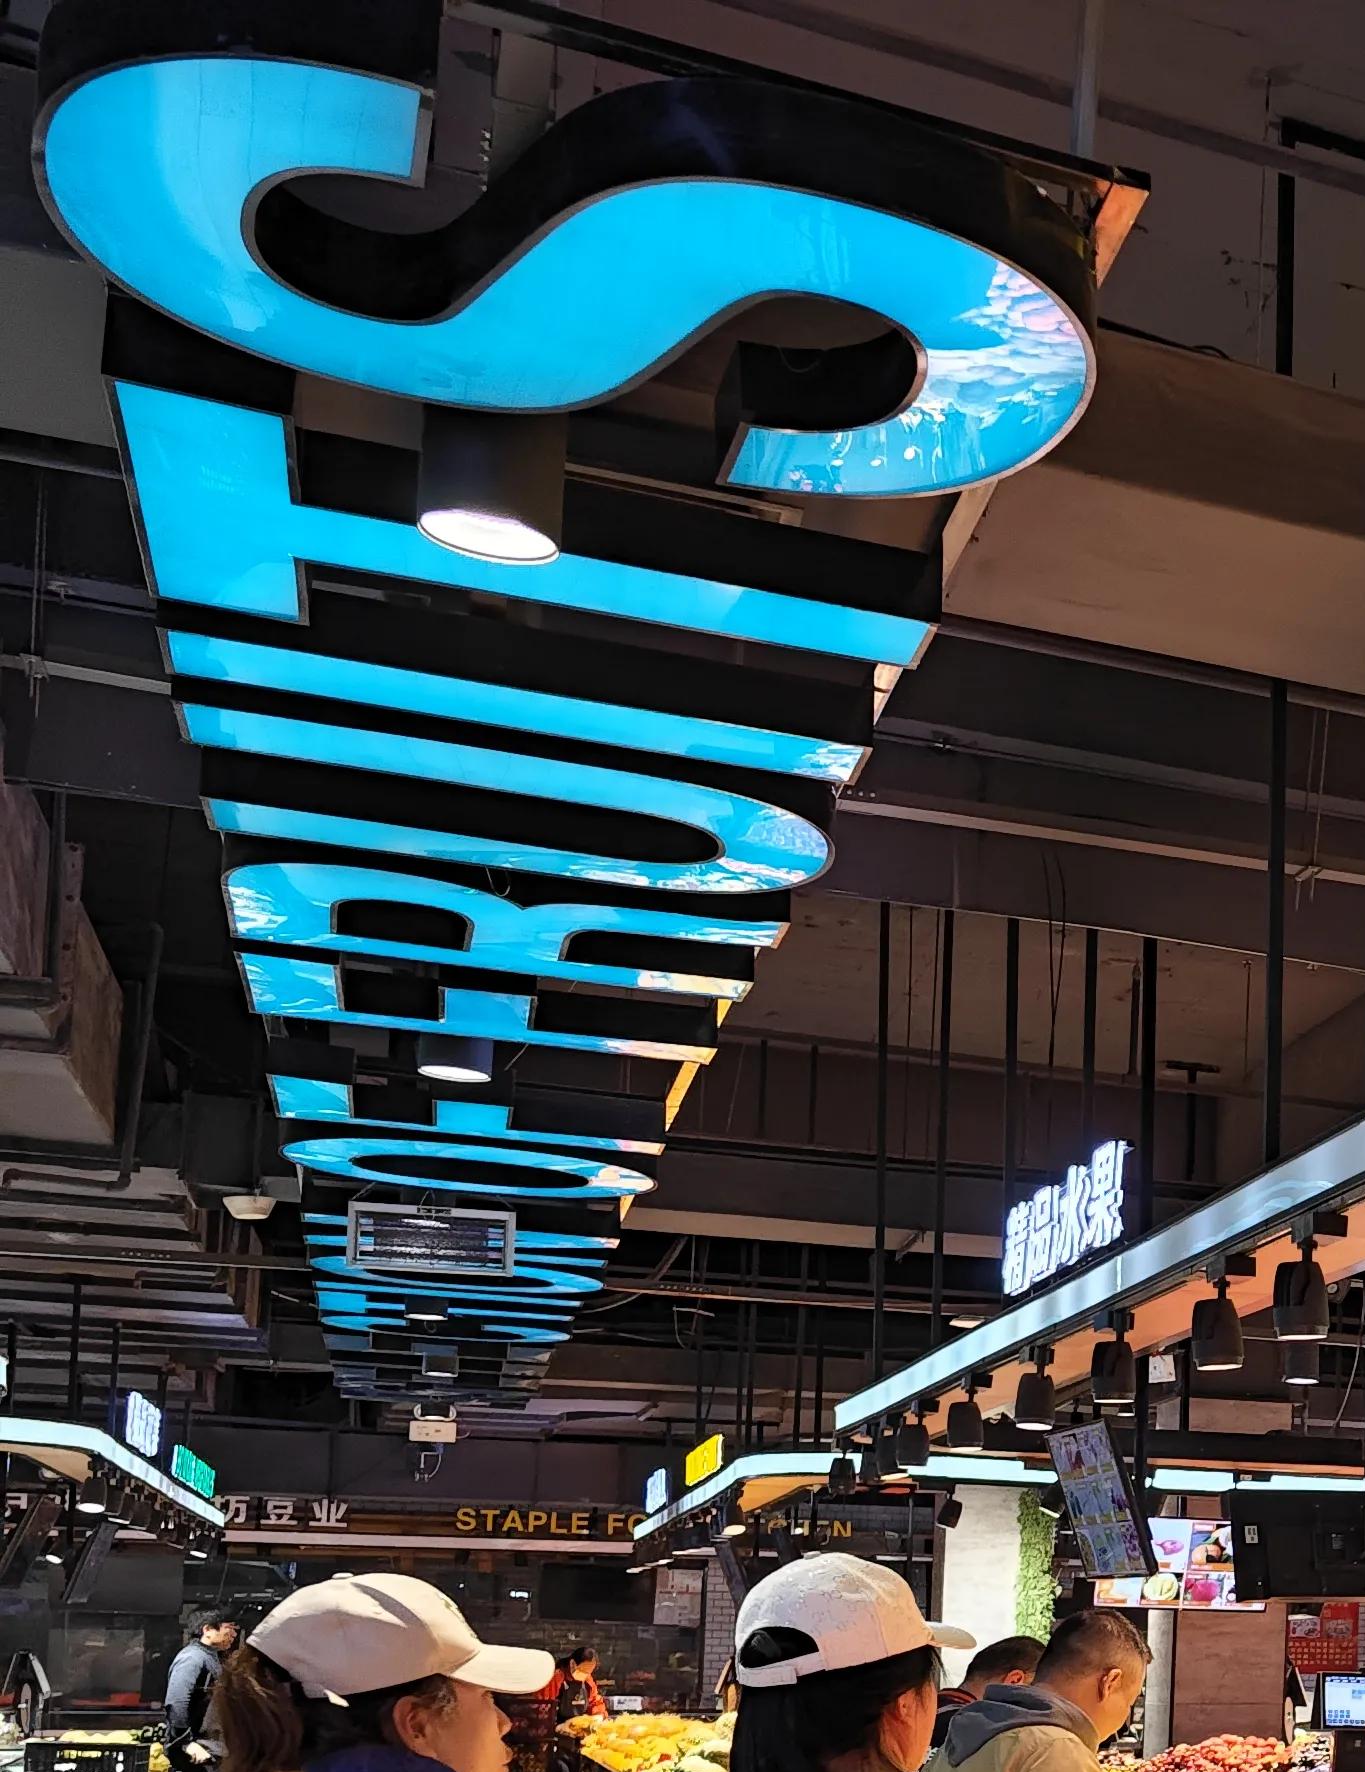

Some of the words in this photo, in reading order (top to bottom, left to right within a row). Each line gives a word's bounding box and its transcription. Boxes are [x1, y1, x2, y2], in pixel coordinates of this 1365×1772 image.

[35, 55, 1098, 1065] FRUITS
[1002, 1139, 1128, 1297] 精品水果
[455, 1506, 589, 1535] STAPLE
